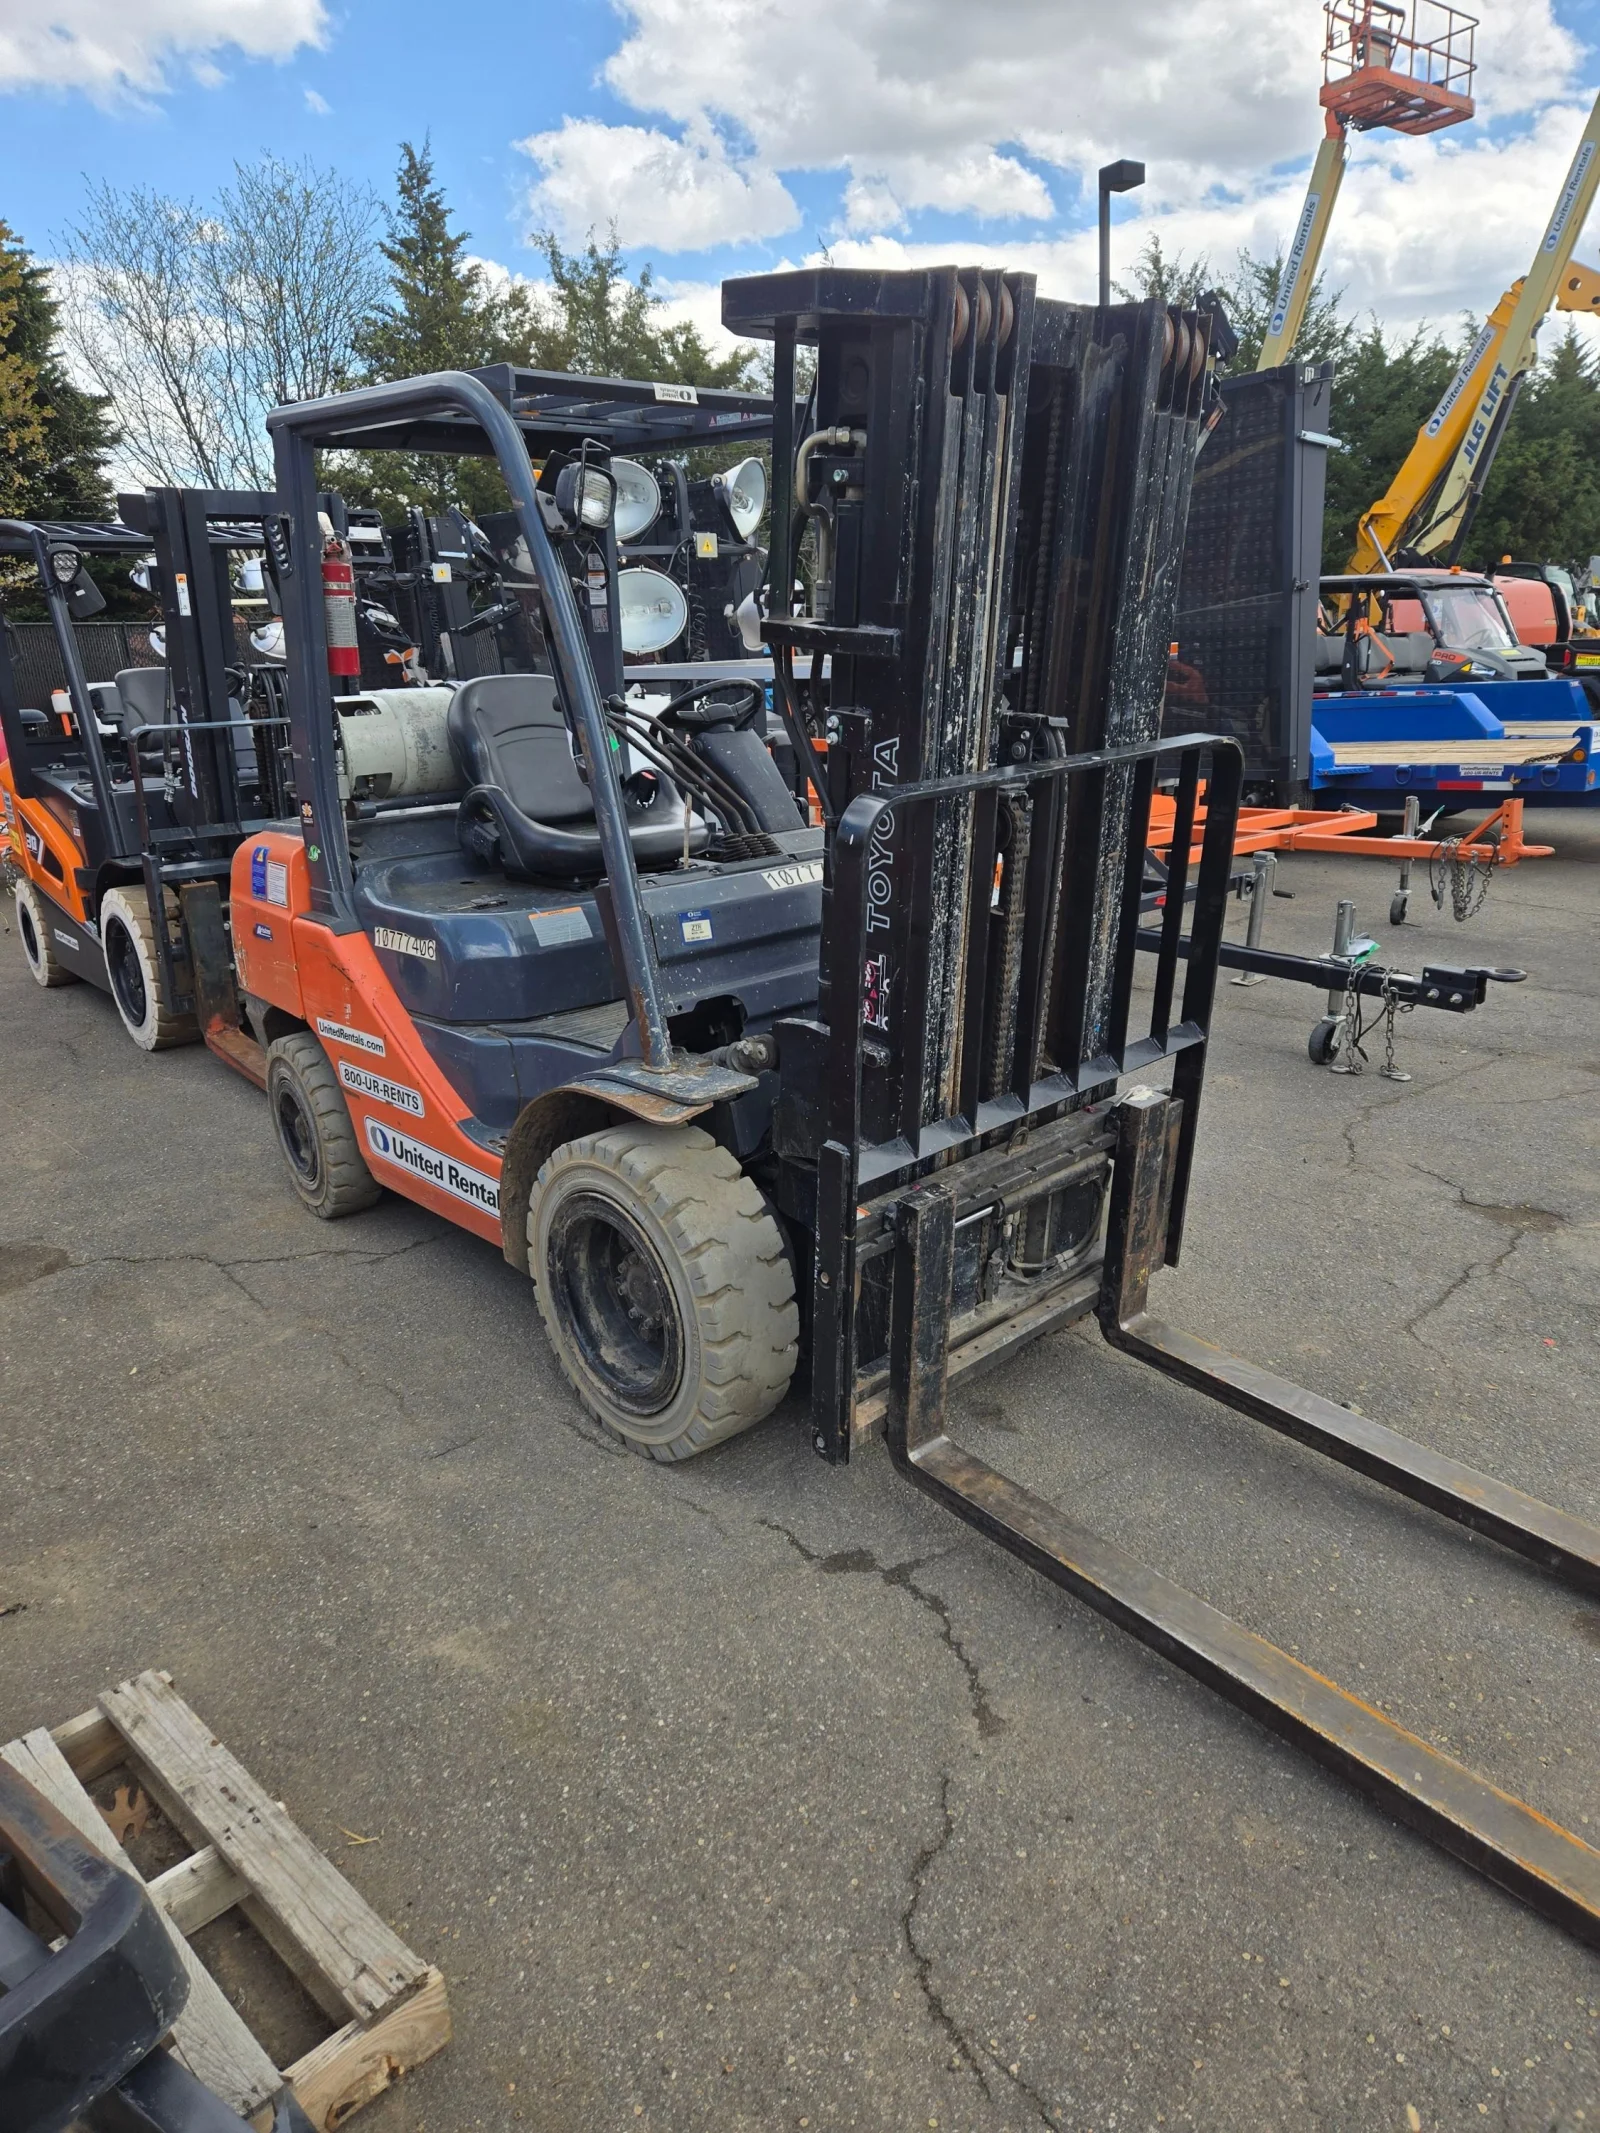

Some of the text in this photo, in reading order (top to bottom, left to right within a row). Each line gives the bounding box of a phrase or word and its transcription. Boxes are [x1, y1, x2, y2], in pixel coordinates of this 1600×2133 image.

[1553, 146, 1592, 232] United Rentals
[1278, 200, 1316, 310] United Rentals
[1438, 331, 1492, 418] United Rentals
[1463, 362, 1509, 465] JLG LIFT
[1433, 651, 1456, 662] PRO
[866, 736, 900, 933] TOYOTA
[375, 927, 435, 958] 10777406
[318, 1021, 384, 1053] UnitedRentals.com
[343, 1067, 420, 1110] 800-UR-RENTS
[392, 1136, 444, 1182] United
